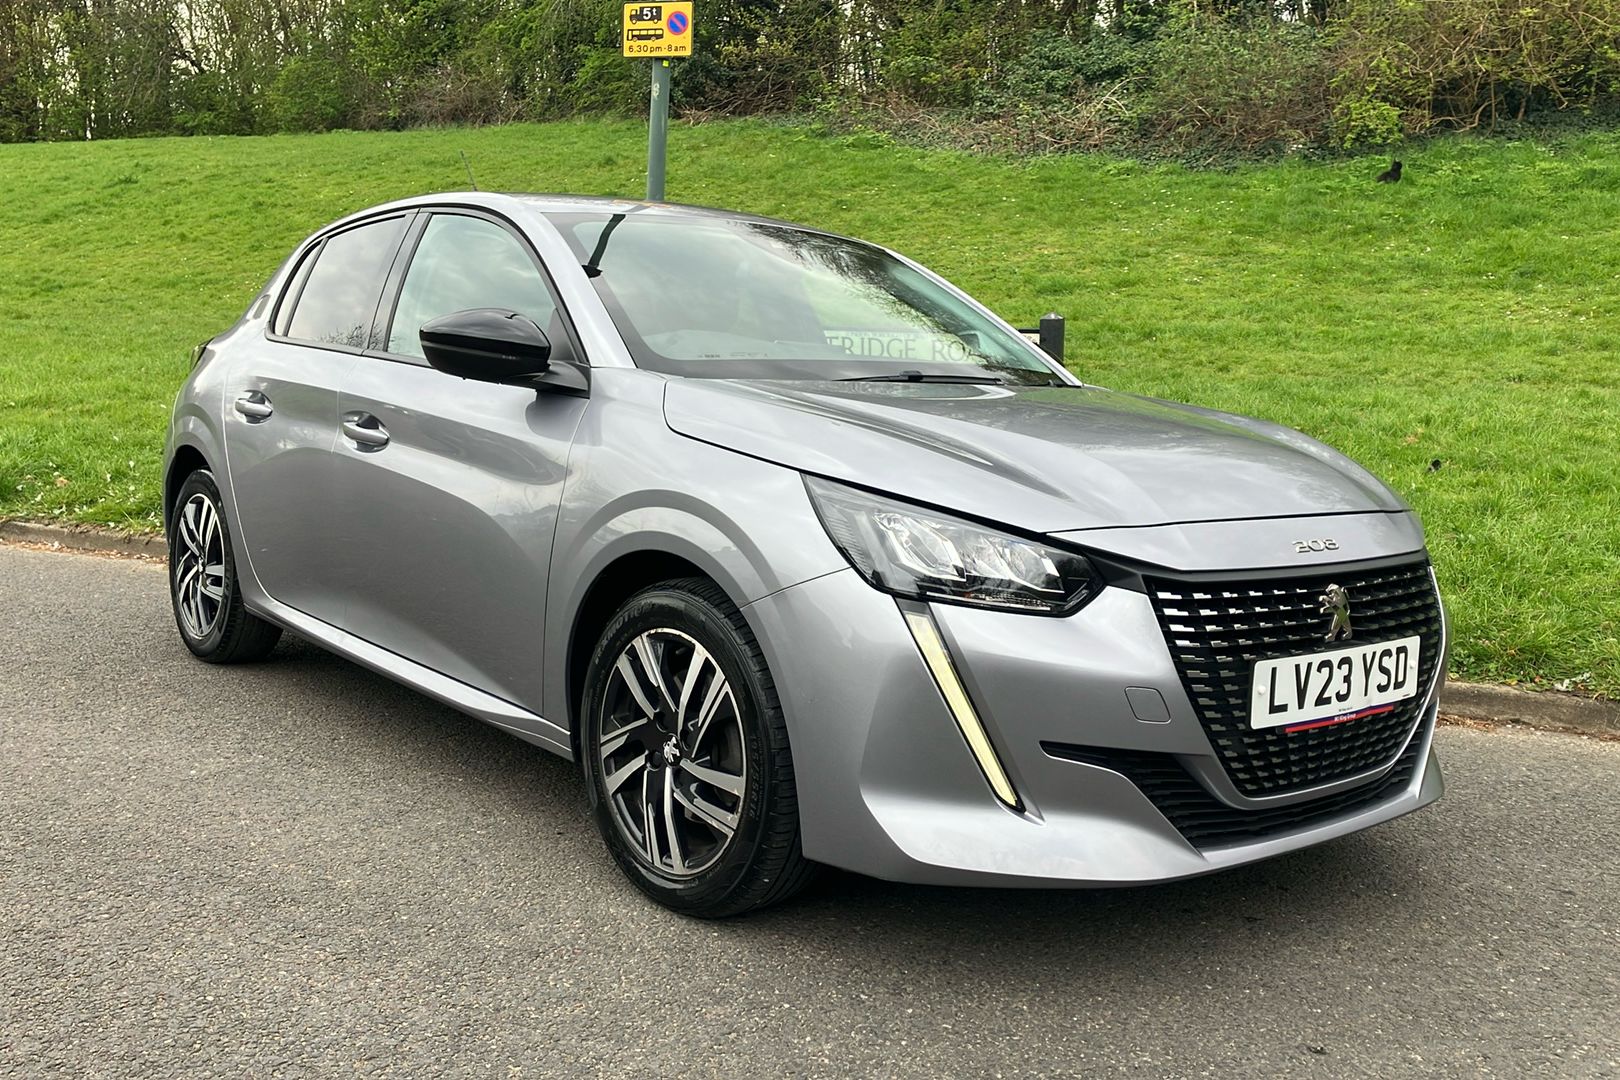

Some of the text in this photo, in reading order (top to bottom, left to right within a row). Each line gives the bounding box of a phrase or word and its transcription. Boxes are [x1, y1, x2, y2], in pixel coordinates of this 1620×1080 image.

[1292, 538, 1340, 554] 208
[1268, 645, 1409, 715] LV23 YSD
